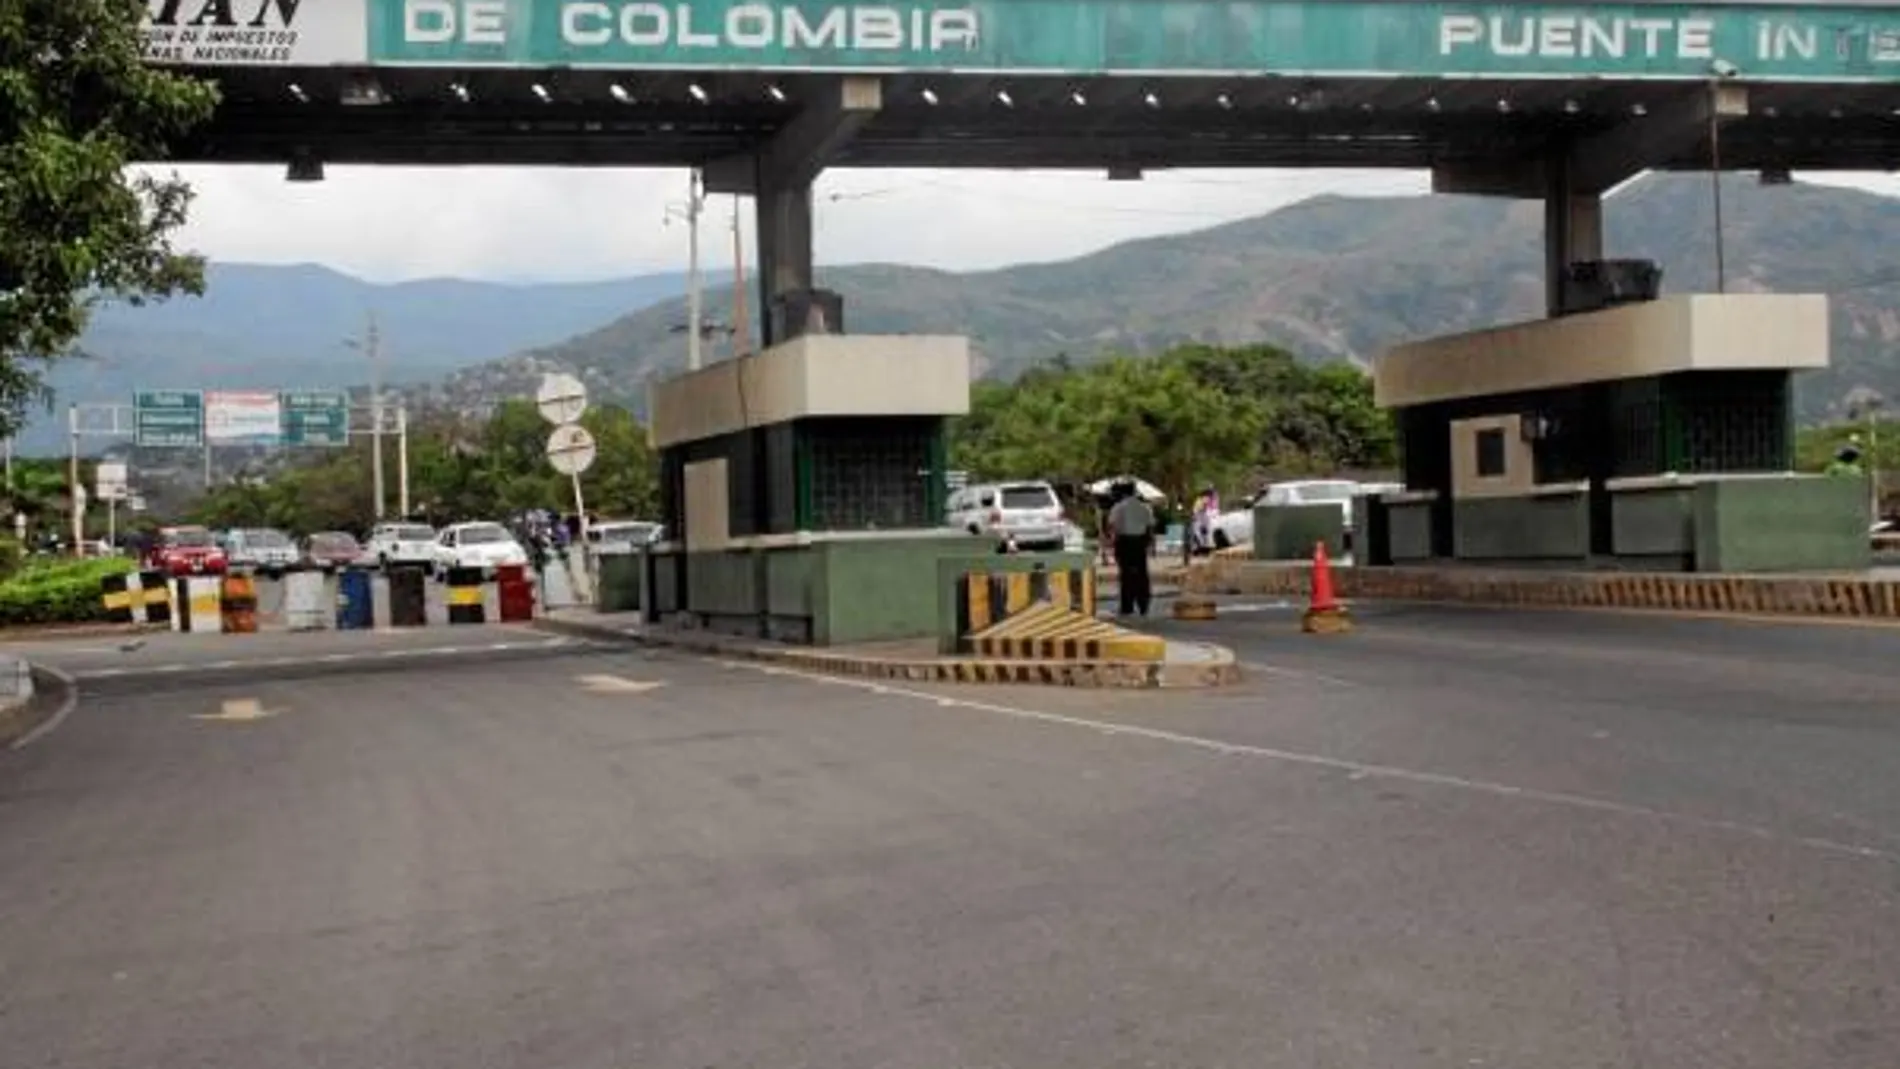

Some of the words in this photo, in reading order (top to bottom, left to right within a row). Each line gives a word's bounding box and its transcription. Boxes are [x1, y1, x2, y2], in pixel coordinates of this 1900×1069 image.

[404, 1, 505, 44] DE
[561, 4, 979, 51] COLOMBIA
[1440, 16, 1714, 58] PUENTE
